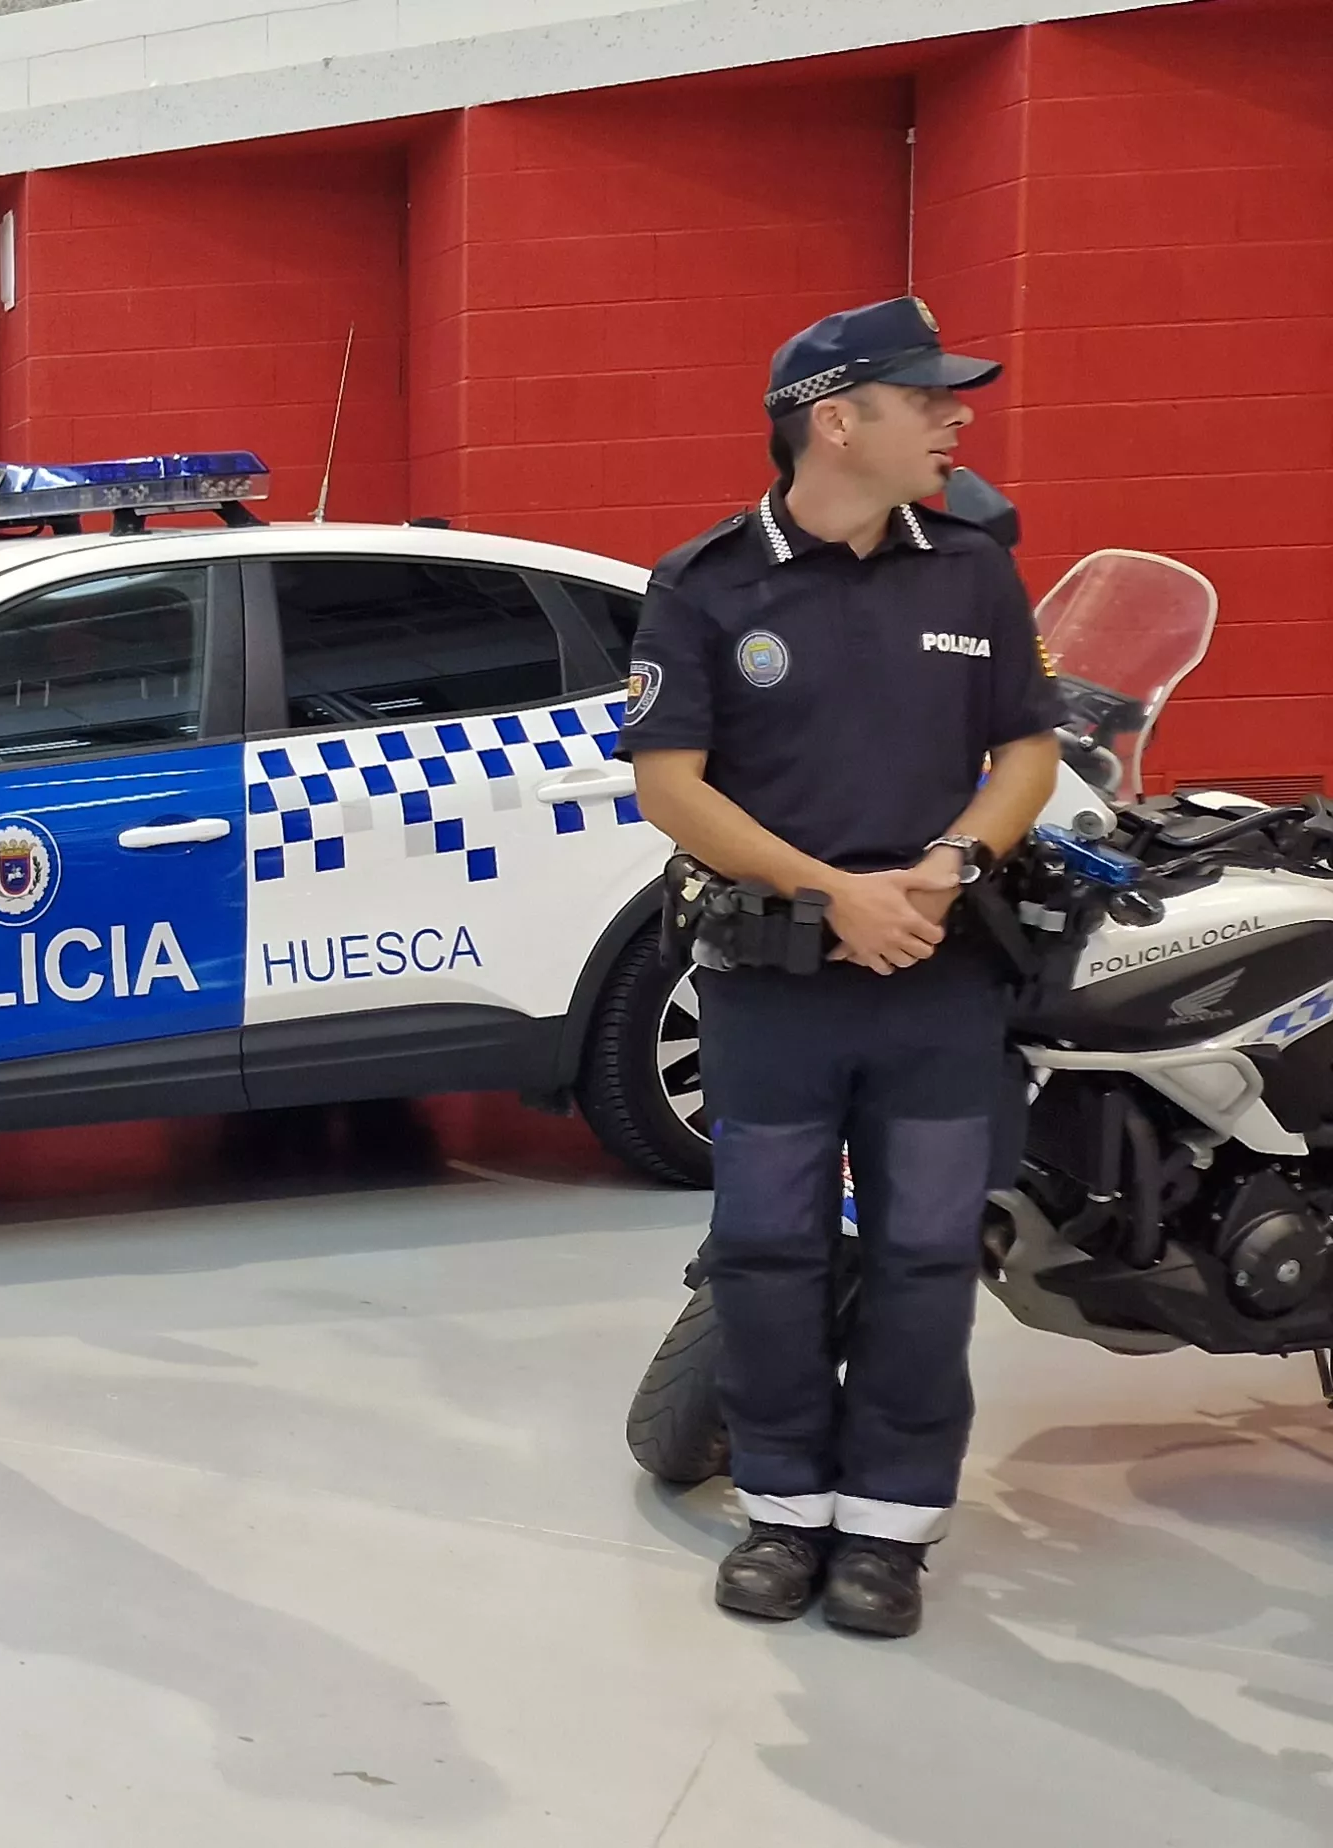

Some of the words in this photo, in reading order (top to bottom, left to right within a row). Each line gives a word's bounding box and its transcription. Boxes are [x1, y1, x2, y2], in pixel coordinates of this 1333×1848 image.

[922, 632, 991, 658] POLICIA
[639, 685, 658, 710] LOCAL
[262, 925, 483, 986] HUESCA
[1090, 941, 1183, 977] POLICIA
[1189, 916, 1266, 950] LOCAL
